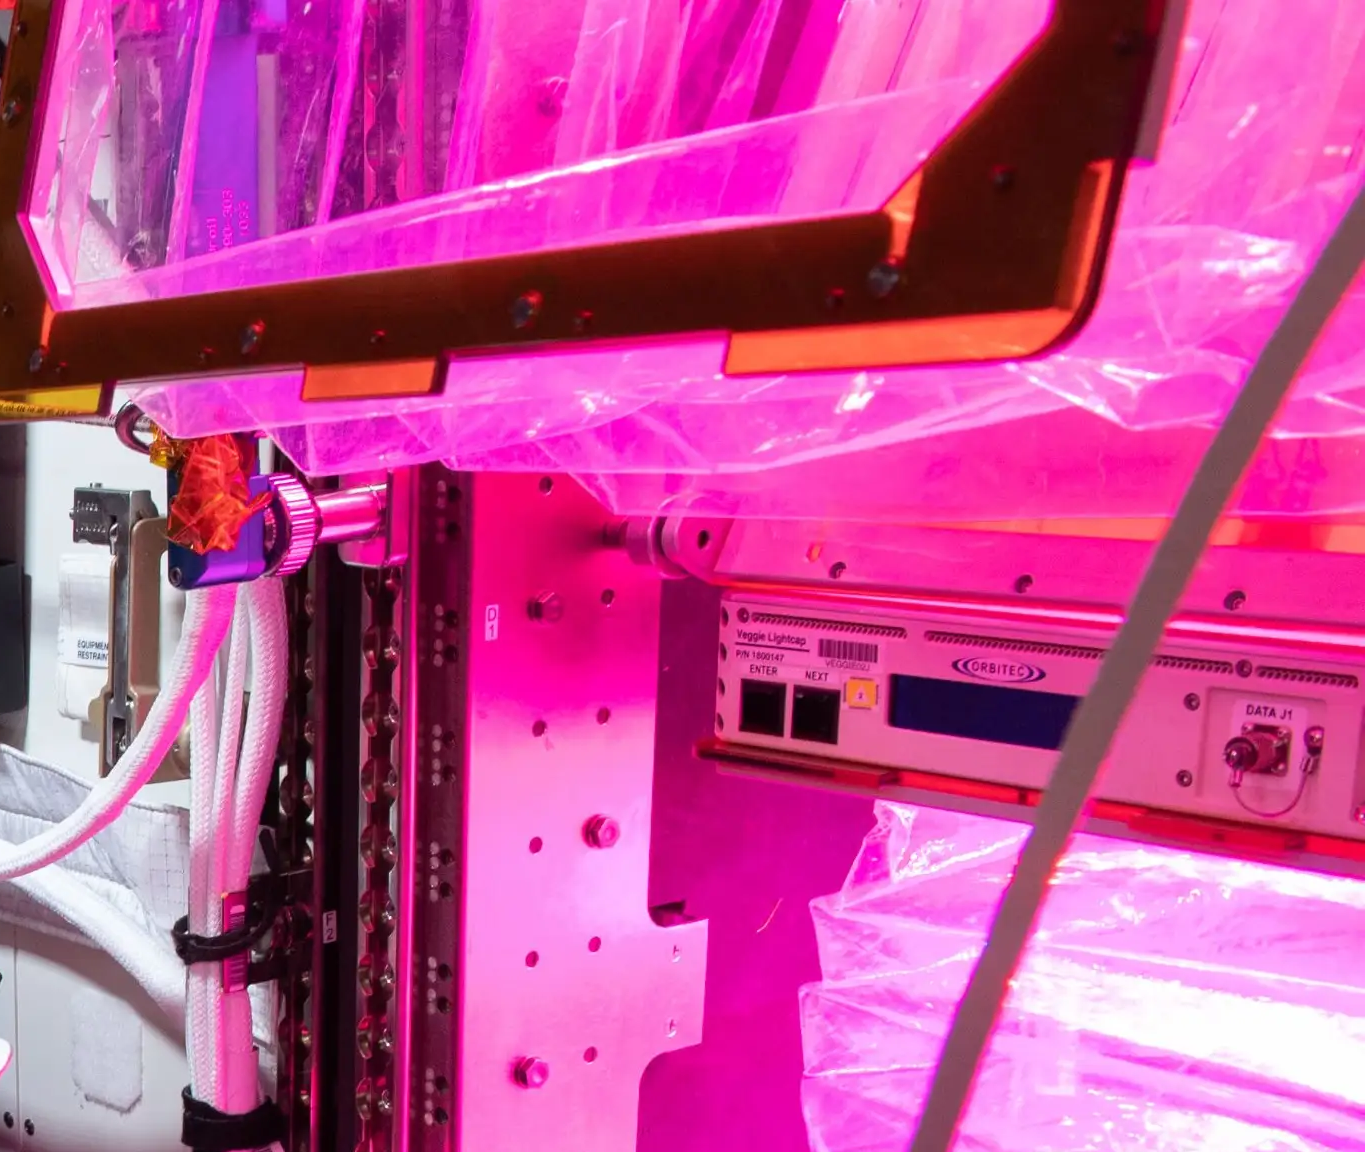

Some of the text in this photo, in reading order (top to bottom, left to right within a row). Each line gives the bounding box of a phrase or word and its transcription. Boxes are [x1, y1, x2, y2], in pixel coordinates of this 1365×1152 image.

[487, 607, 497, 621] D
[77, 639, 109, 650] EQUIPMEN
[736, 629, 807, 648] Veggie Lightcap
[77, 649, 109, 661] RESTRAIN
[735, 650, 785, 662] P/N 1800147
[749, 664, 778, 676] ENTER
[970, 660, 1026, 678] ORBITEC
[805, 670, 829, 683] NEXT
[1245, 703, 1294, 721] DATA J1
[325, 914, 334, 926] F
[325, 927, 335, 940] 2
